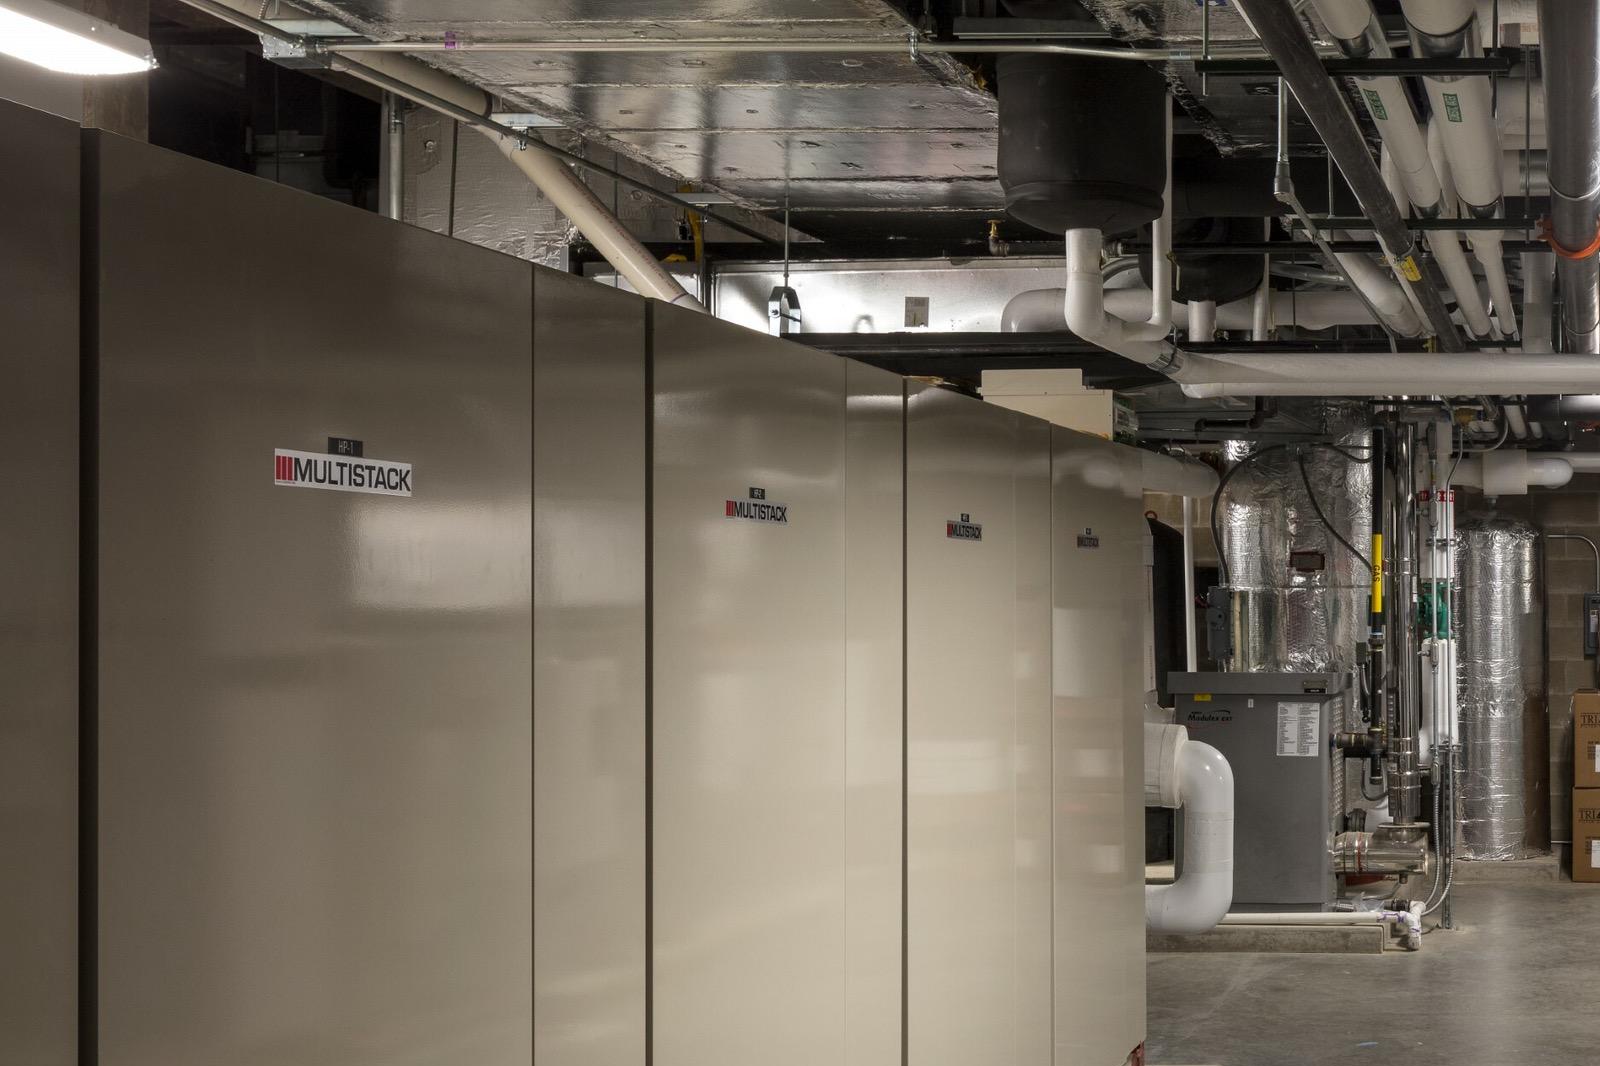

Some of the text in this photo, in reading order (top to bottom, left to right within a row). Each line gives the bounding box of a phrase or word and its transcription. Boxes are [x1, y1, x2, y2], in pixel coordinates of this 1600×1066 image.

[338, 440, 354, 455] HP-1
[293, 457, 411, 492] MULTISTACK
[734, 501, 788, 522] MULTISTACK
[1373, 564, 1381, 583] GAS
